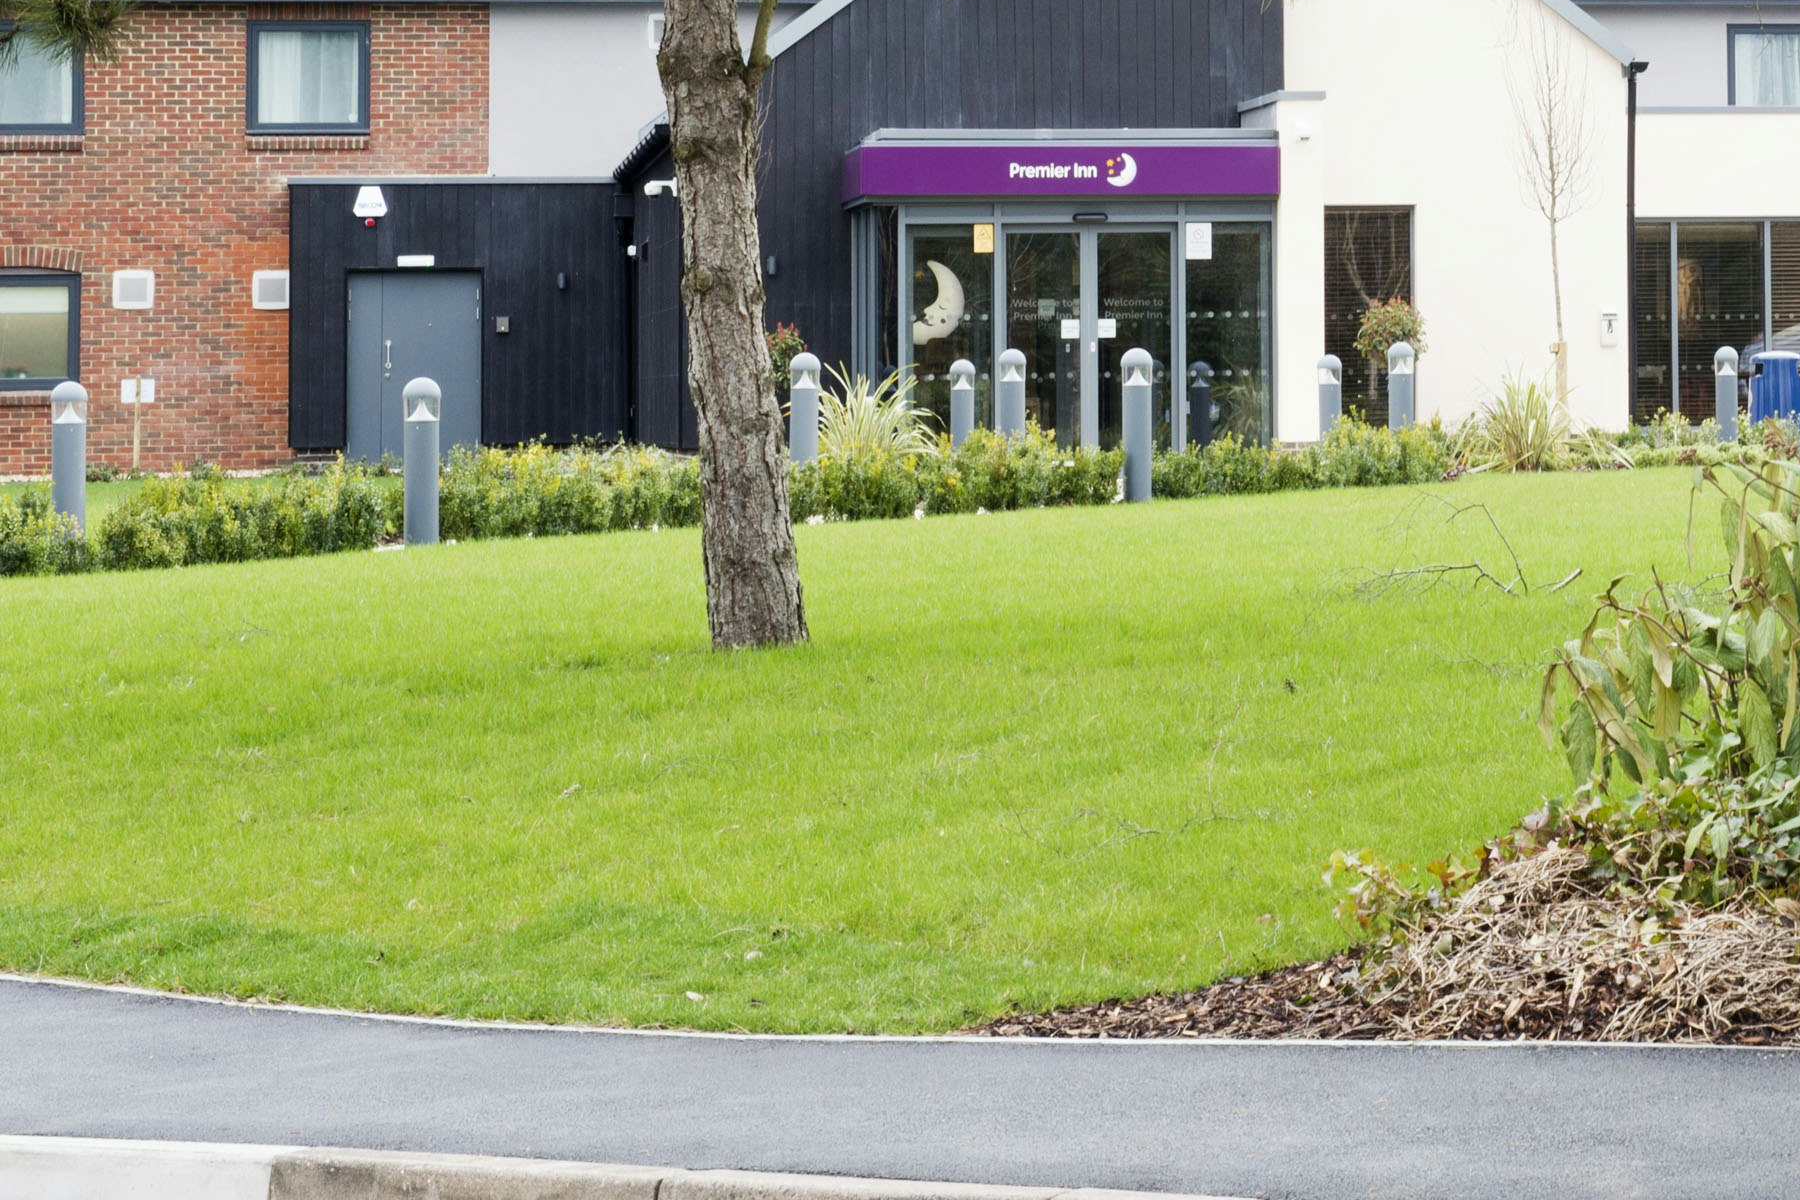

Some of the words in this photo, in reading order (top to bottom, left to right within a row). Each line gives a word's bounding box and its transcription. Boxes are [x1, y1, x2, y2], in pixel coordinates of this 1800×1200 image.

[1009, 162, 1071, 179] Premier
[1073, 162, 1098, 179] Inn
[1011, 298, 1061, 308] Welce
[1062, 299, 1073, 308] to
[1103, 297, 1152, 307] Welcome
[1152, 298, 1164, 307] to
[1104, 310, 1145, 320] Premier
[1146, 310, 1164, 320] Inn
